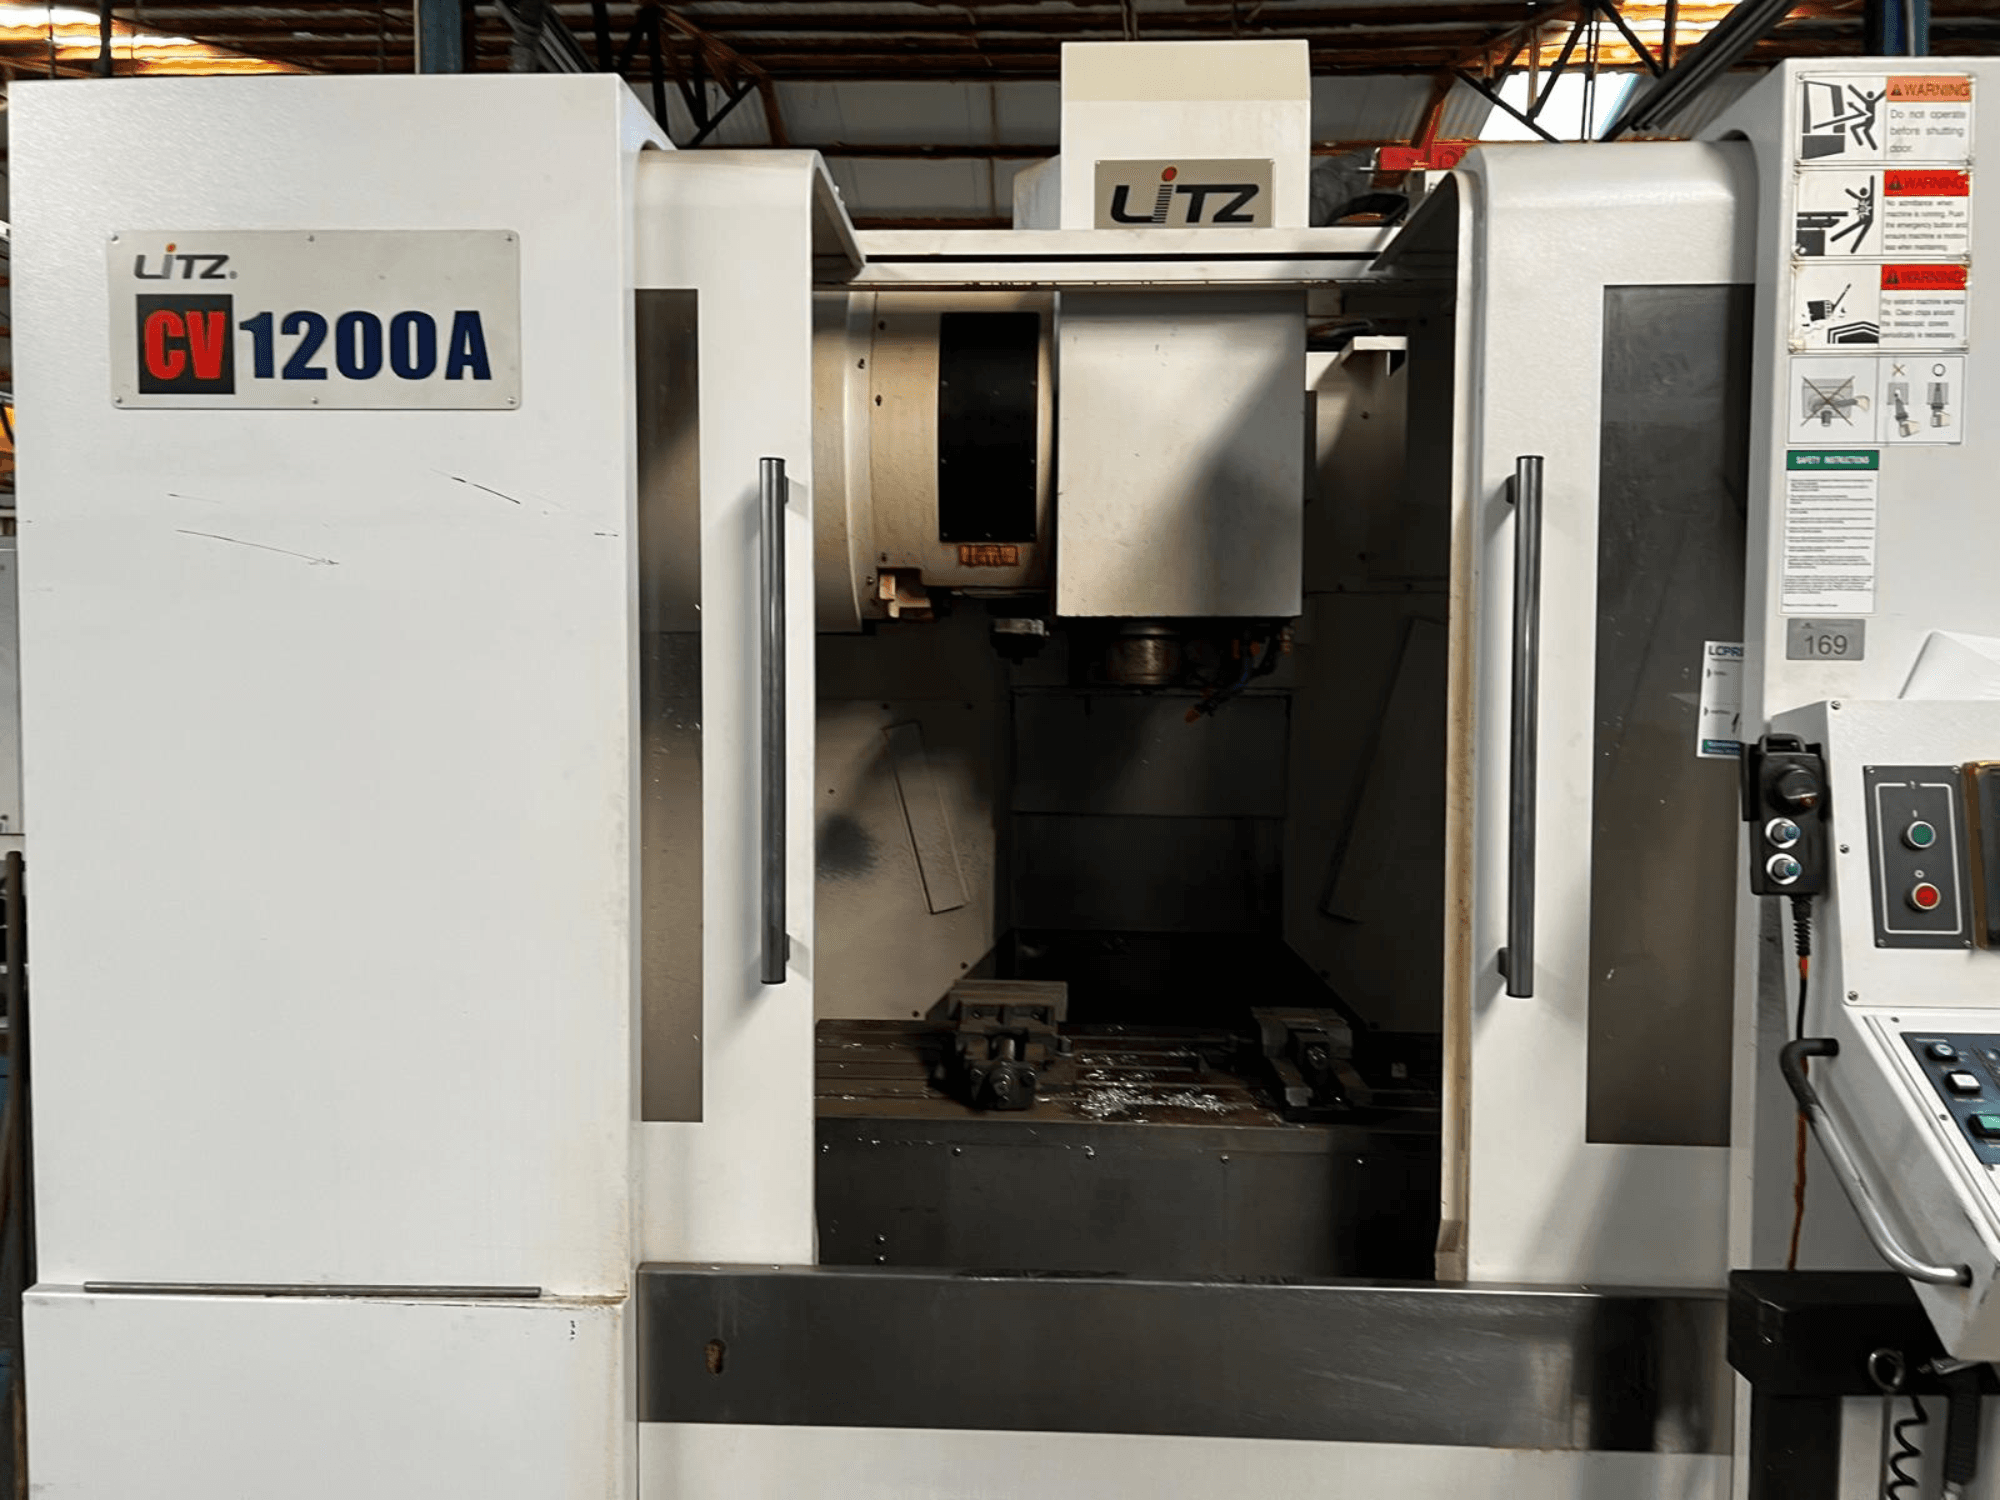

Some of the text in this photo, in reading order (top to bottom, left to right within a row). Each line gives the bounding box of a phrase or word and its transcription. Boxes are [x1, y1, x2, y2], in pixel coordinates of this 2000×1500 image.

[1904, 83, 1970, 97] WARNING
[1890, 109, 1966, 120] Do not operate
[1890, 126, 1964, 138] before shutting
[1904, 176, 1965, 190] WARNING
[1804, 634, 1849, 656] 169
